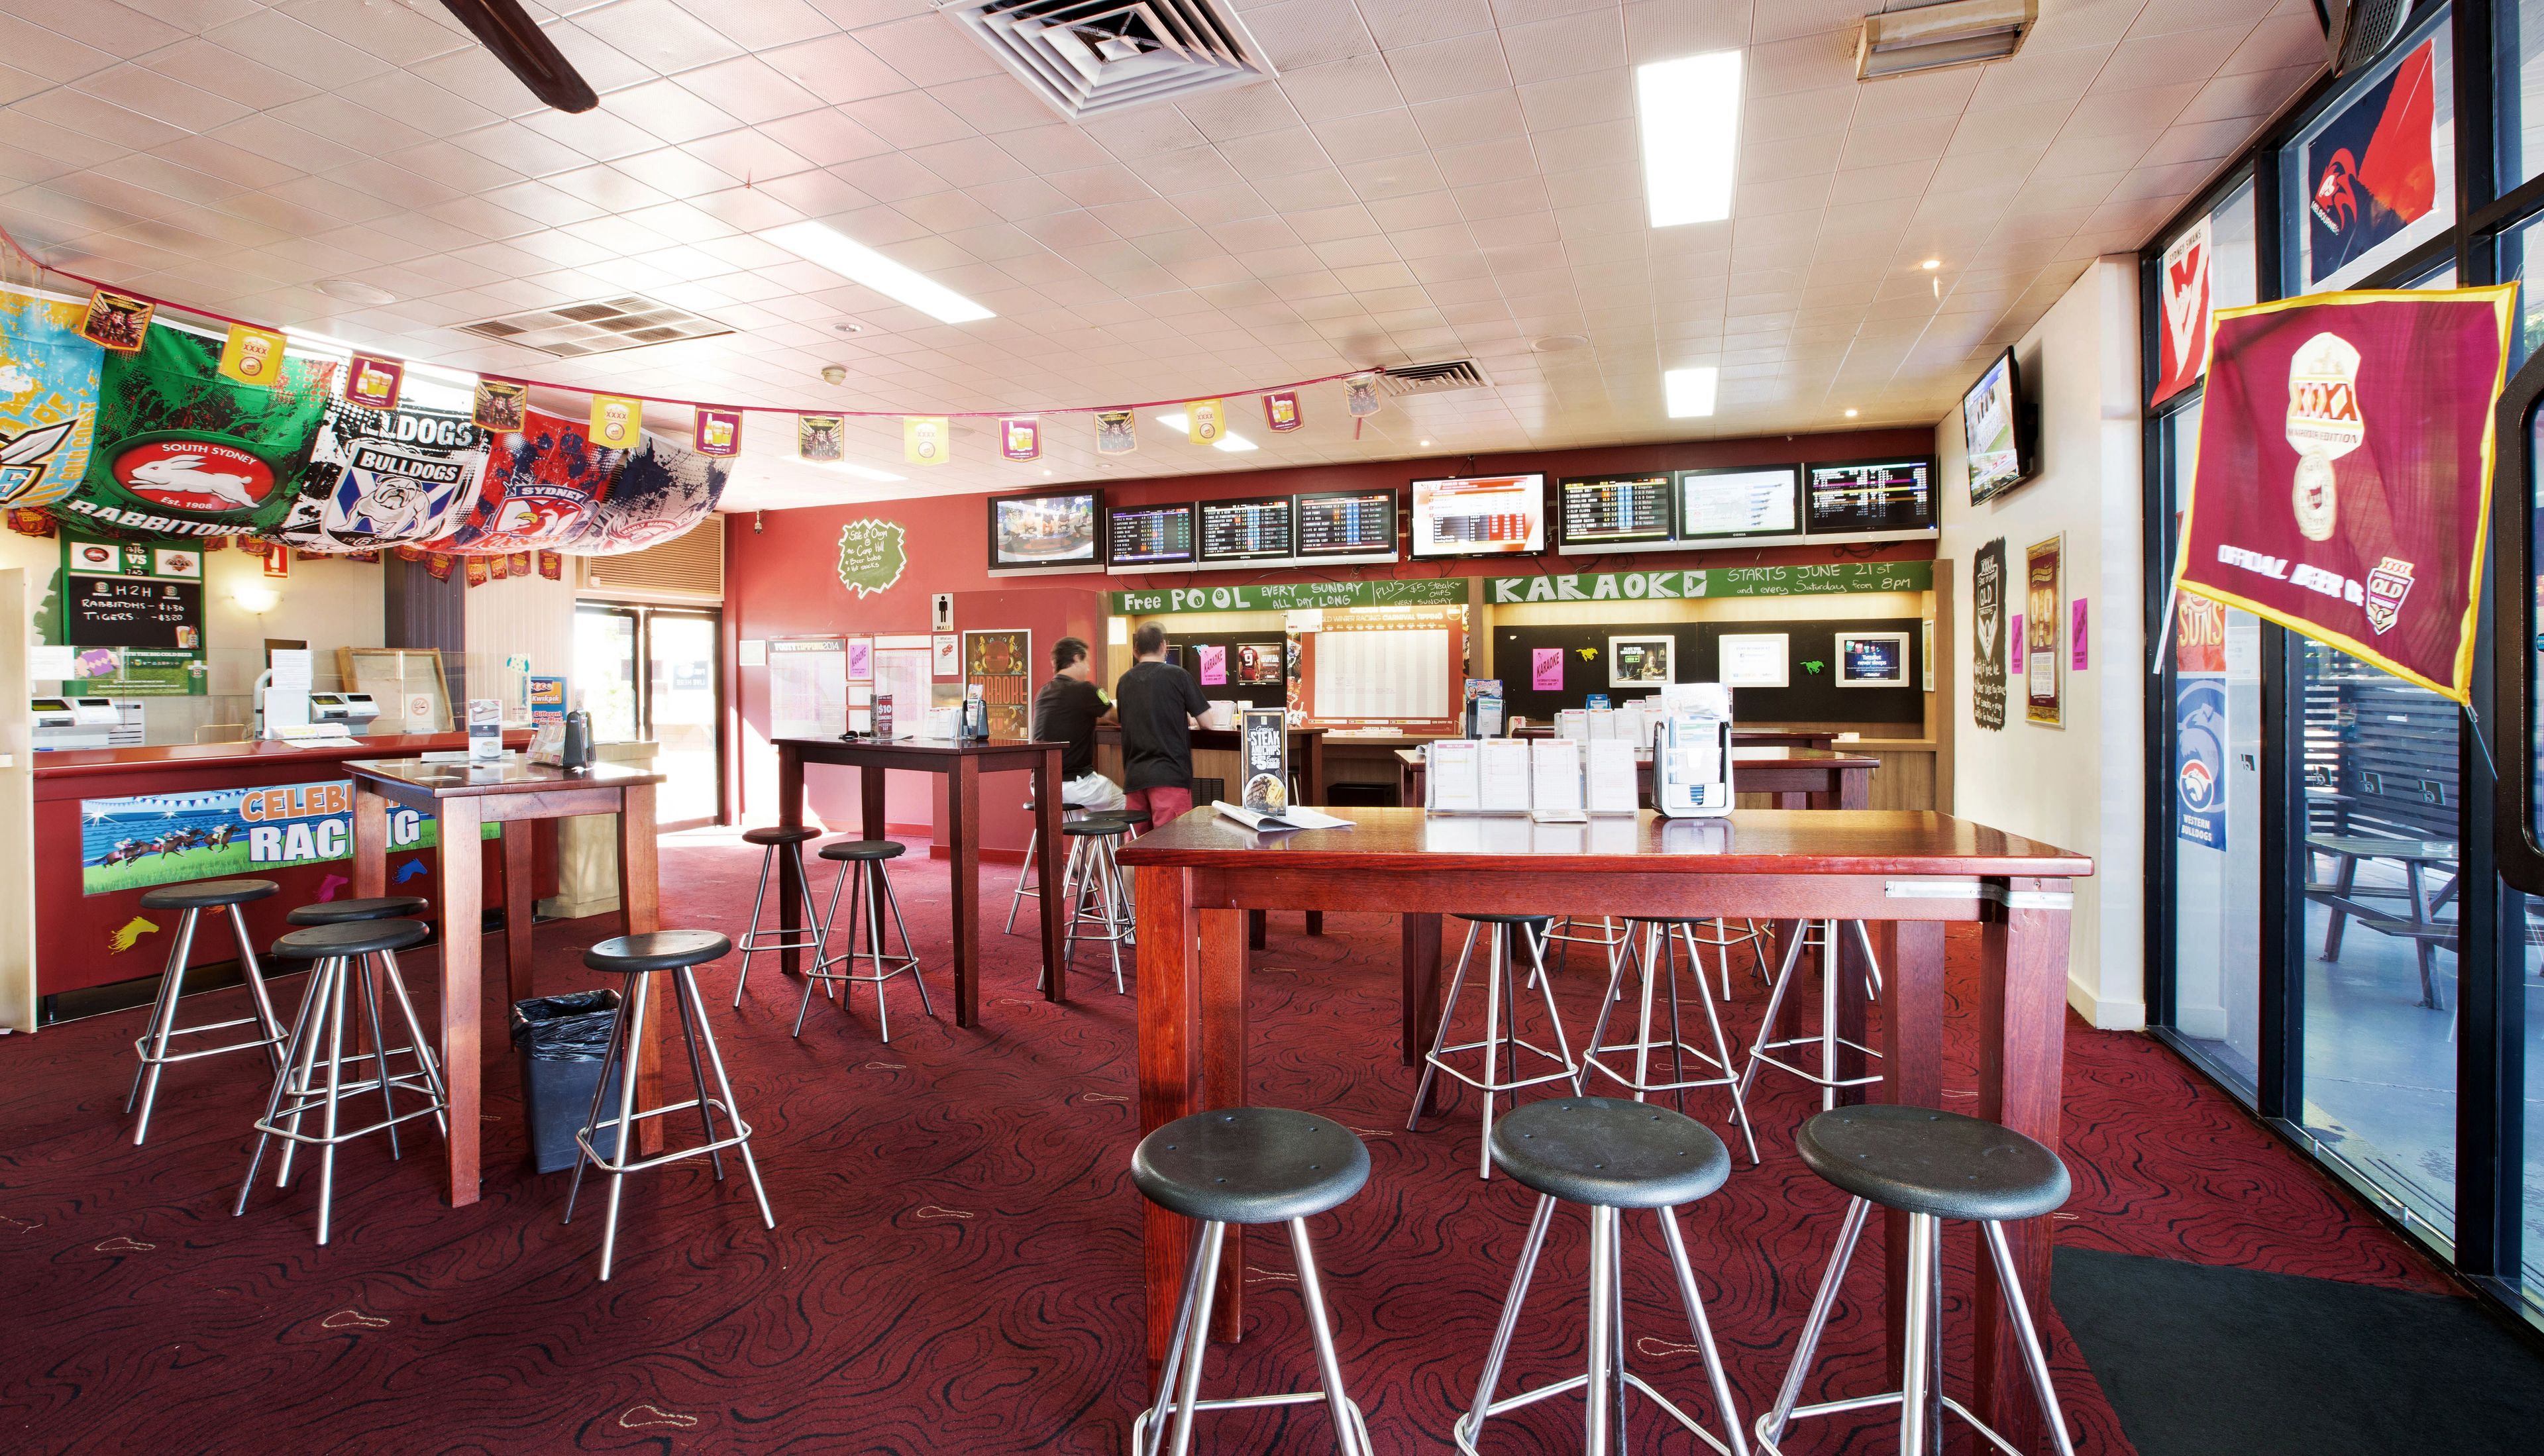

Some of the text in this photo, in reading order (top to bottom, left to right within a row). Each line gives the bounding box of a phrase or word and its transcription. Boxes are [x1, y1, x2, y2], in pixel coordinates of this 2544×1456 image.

[2169, 229, 2202, 264] SYDNEY SWANS
[243, 343, 267, 355] XXXX
[604, 411, 626, 419] XXXX
[162, 444, 257, 466] SOUTH SYDNEY
[361, 450, 458, 482] BULLDOGS
[521, 485, 584, 502] SYDNEY
[160, 496, 213, 509] Est. 1908
[67, 499, 258, 536] RABBITOHS
[621, 523, 645, 535] MANLY
[126, 554, 148, 565] VS
[1727, 566, 1787, 582] STARTS
[1797, 564, 1840, 579] JUNE
[2217, 545, 2289, 580] OFFICIAL
[2288, 563, 2345, 598] BEER
[1261, 582, 1363, 598] EVERY SUNDAY
[1376, 580, 1454, 599] PLUS $5 Steak
[1428, 589, 1452, 598] CHIPS
[1736, 584, 1753, 594] and
[1760, 586, 1789, 595] every
[1794, 580, 1847, 594] Saturday
[1852, 579, 1873, 590] from
[2370, 578, 2404, 599] QLD
[1124, 587, 1251, 611] Free POOL
[1272, 595, 1351, 610] ALL DAY LONG
[1980, 584, 1992, 607] QLD
[81, 599, 146, 609] RABBITOHS
[82, 611, 134, 621] TIGERS
[2178, 603, 2225, 647] SUNS
[1204, 649, 1223, 674] KARAOKE
[1244, 654, 1253, 666] 9
[1536, 651, 1560, 678] KARAOKE
[531, 694, 560, 704] Kwikpik
[878, 703, 892, 715] $10
[1251, 730, 1281, 746] STEAK
[1262, 745, 1281, 756] CHIPS
[1251, 755, 1267, 770] $5
[2183, 814, 2211, 831] WESTERN
[2181, 825, 2213, 843] BULLDOGS
